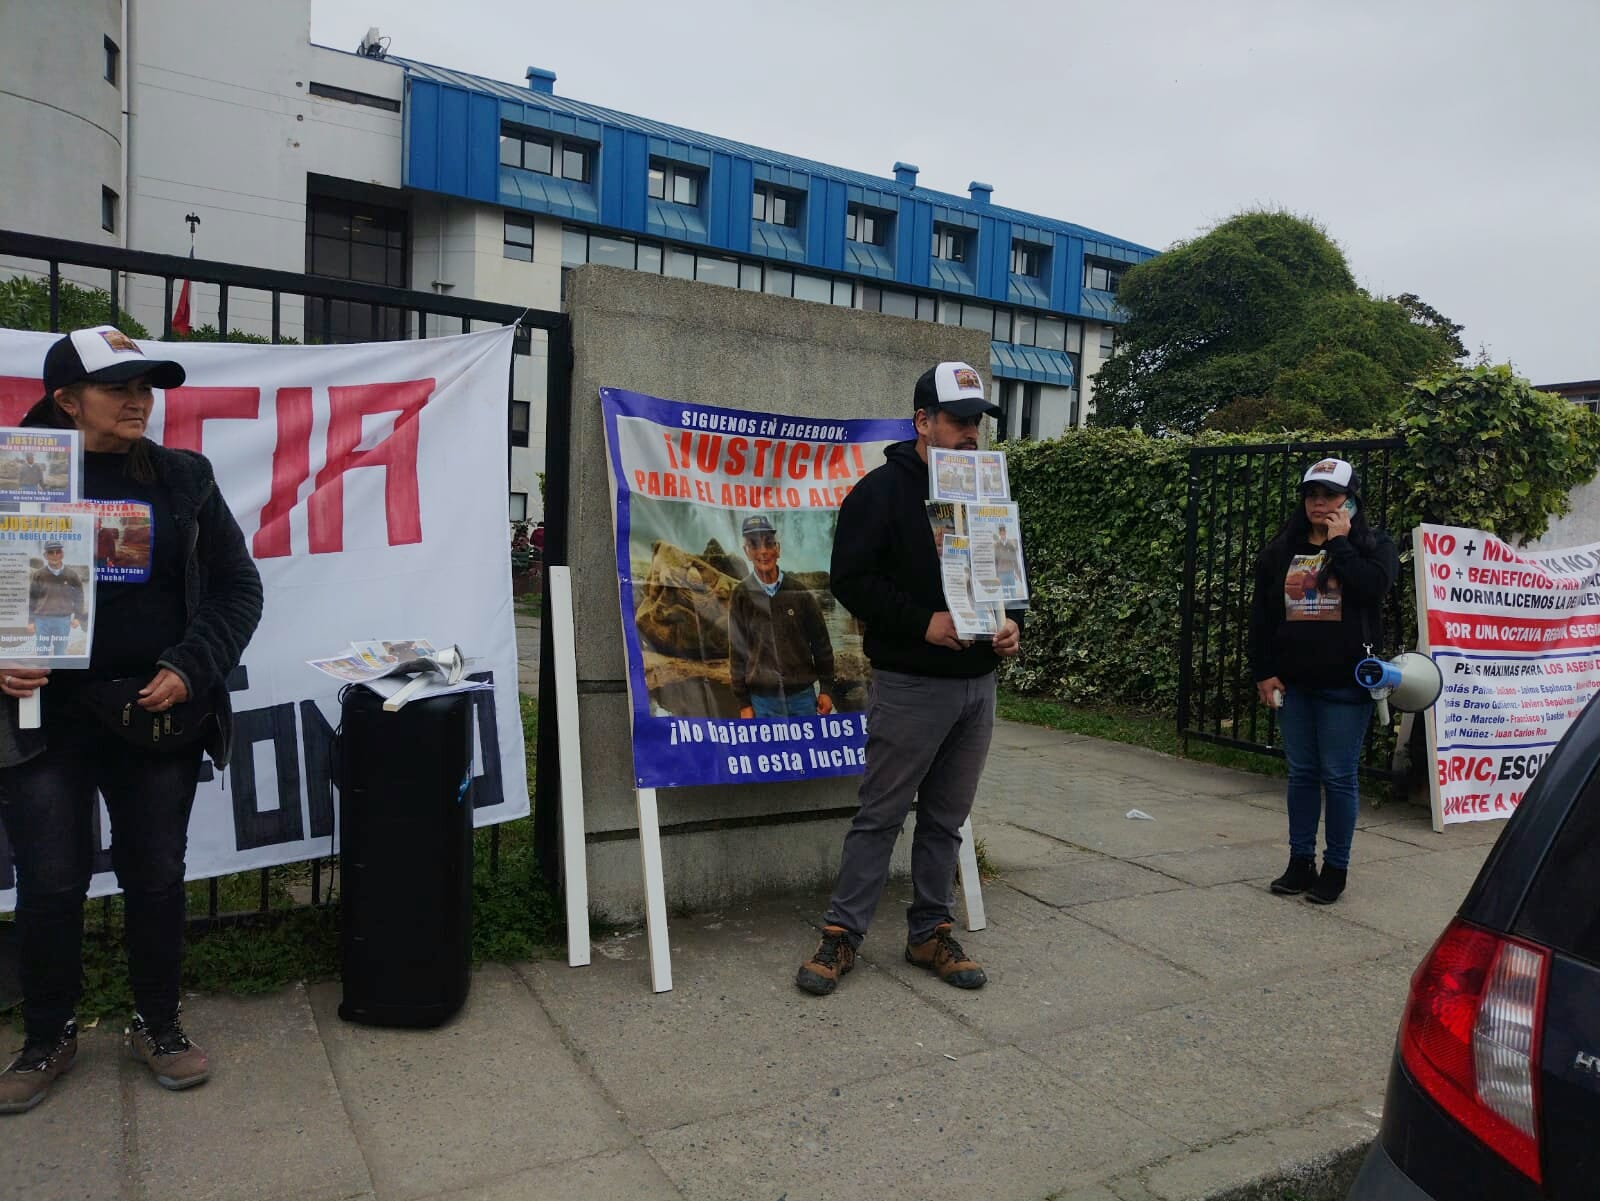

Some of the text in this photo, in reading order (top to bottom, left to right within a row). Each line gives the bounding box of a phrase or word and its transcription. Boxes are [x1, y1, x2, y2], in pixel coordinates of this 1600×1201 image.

[681, 410, 848, 440] SIGUENOS EN FACEBOOK:
[664, 431, 866, 480] ¡JUSTICIA!
[634, 470, 692, 498] PARA
[695, 479, 715, 504] EL
[721, 483, 801, 508] ABUELO
[1423, 532, 1456, 557] NO
[1463, 540, 1477, 556] +
[1468, 566, 1554, 590] BENEFICIOS
[1433, 584, 1447, 600] NO
[1450, 587, 1555, 610] NORMALICEMOS
[1475, 624, 1499, 641] UNA
[1501, 626, 1541, 642] OCTAVA
[1483, 661, 1520, 677] MÁXIMAS
[1521, 664, 1544, 677] PARA
[1544, 663, 1564, 675] LOS
[1463, 699, 1490, 710] Bravo
[670, 720, 703, 745] ¡No
[707, 720, 815, 745] bajaremos
[821, 717, 854, 738] los
[1470, 715, 1505, 725] Marcelo
[1459, 728, 1489, 739] Núñez
[1495, 728, 1512, 738] Juan
[1514, 728, 1535, 738] Carlos
[728, 755, 752, 774] en
[758, 751, 802, 773] esta
[1494, 792, 1508, 812] A
